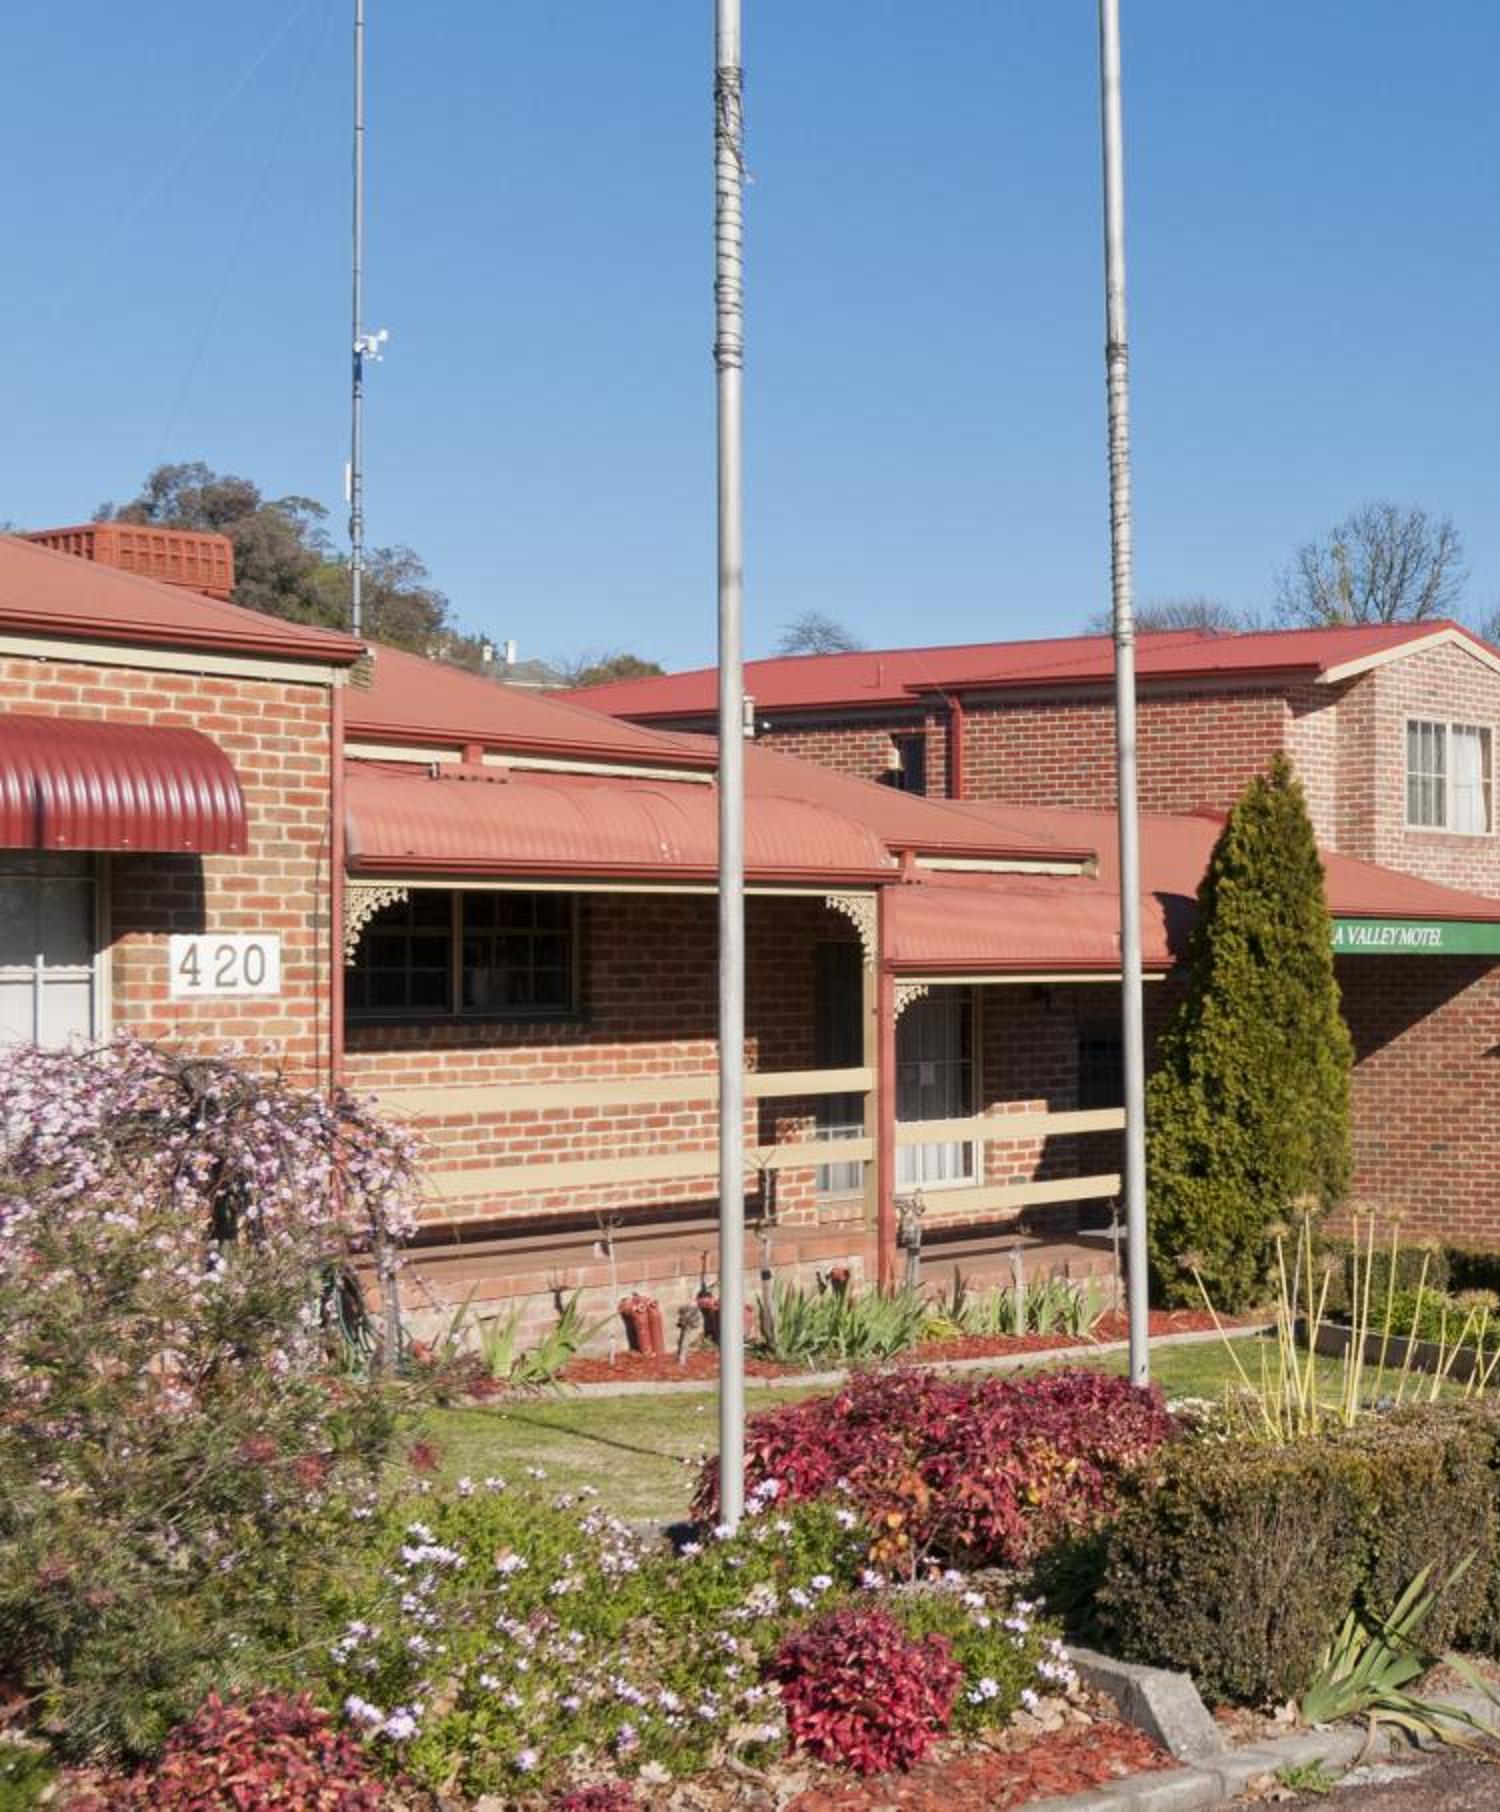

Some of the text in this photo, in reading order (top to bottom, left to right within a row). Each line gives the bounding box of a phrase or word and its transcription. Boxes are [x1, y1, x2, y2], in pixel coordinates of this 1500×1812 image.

[1347, 925, 1400, 945] VALLEY
[1399, 927, 1444, 946] MOTEL
[178, 943, 266, 987] 420
